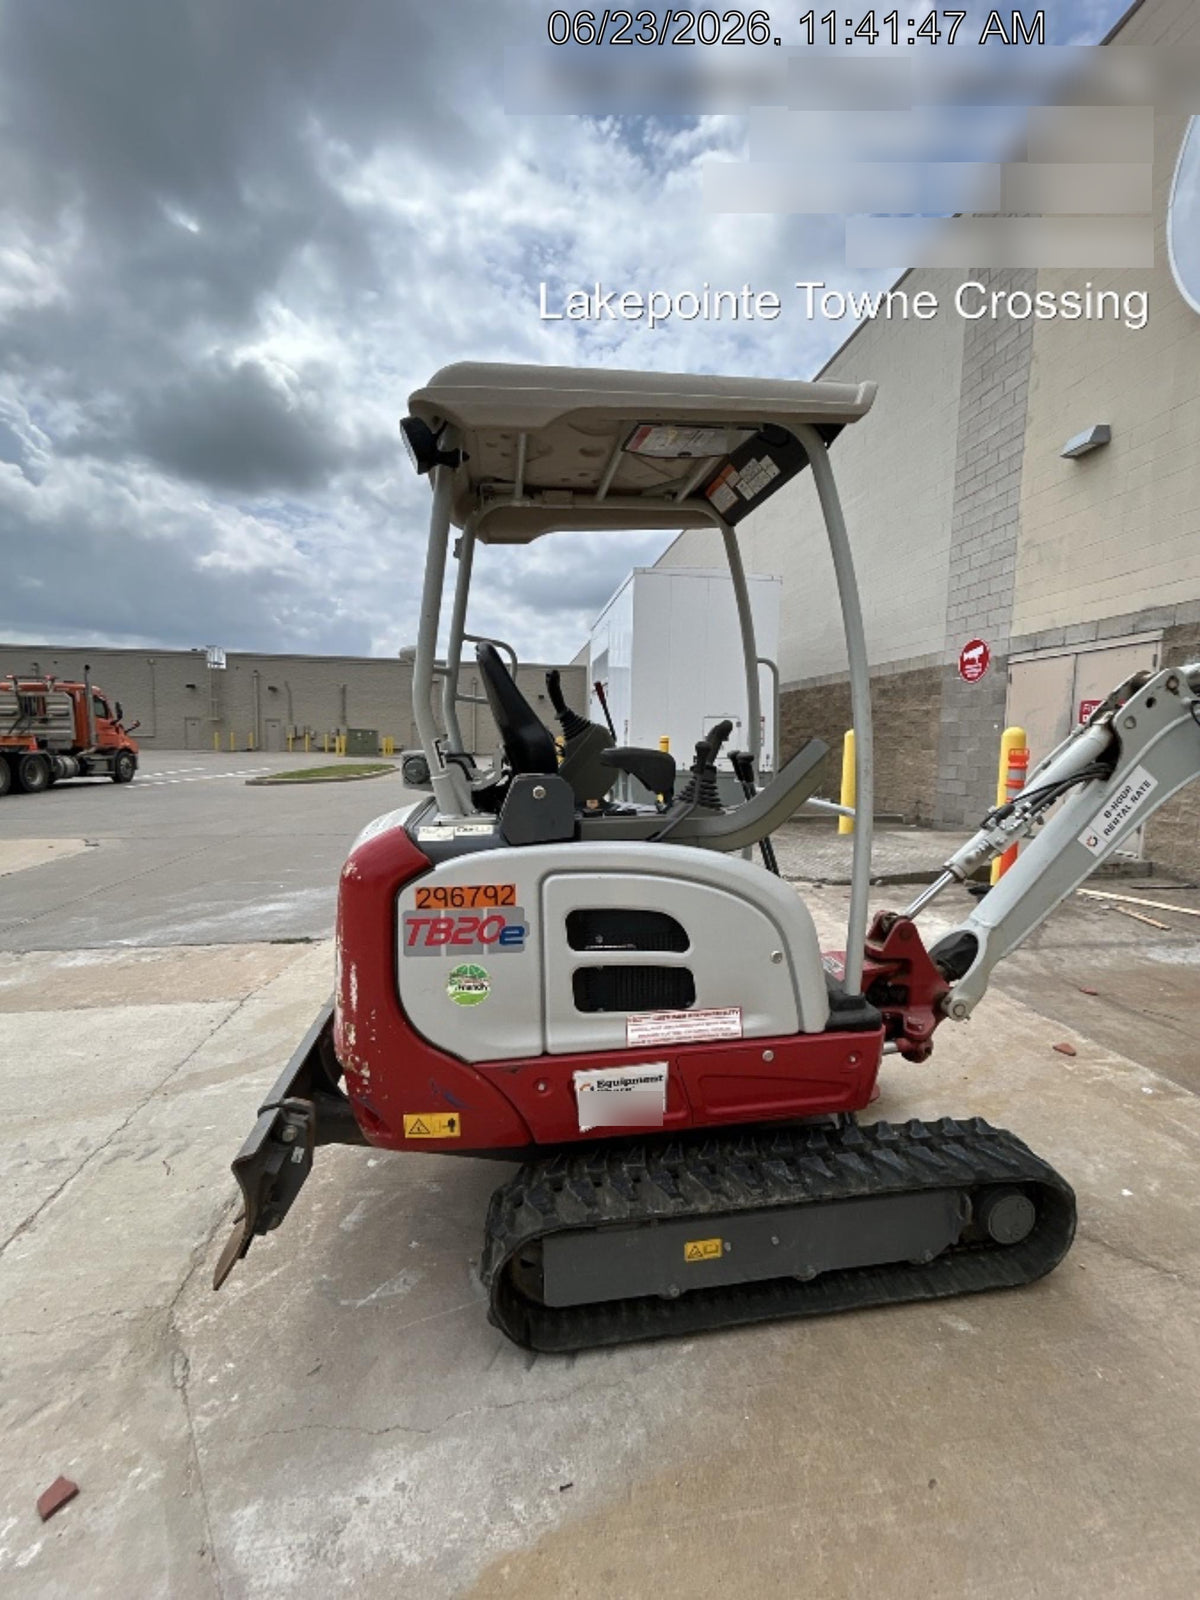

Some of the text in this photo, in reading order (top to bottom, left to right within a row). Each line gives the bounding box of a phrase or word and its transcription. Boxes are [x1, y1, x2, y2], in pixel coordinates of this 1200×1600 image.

[1104, 785, 1133, 818] 8-HOUR
[1104, 780, 1152, 836] RENTAL RATE
[416, 884, 515, 909] 296792
[406, 915, 525, 946] TB20e
[596, 1075, 664, 1088] Equipment
